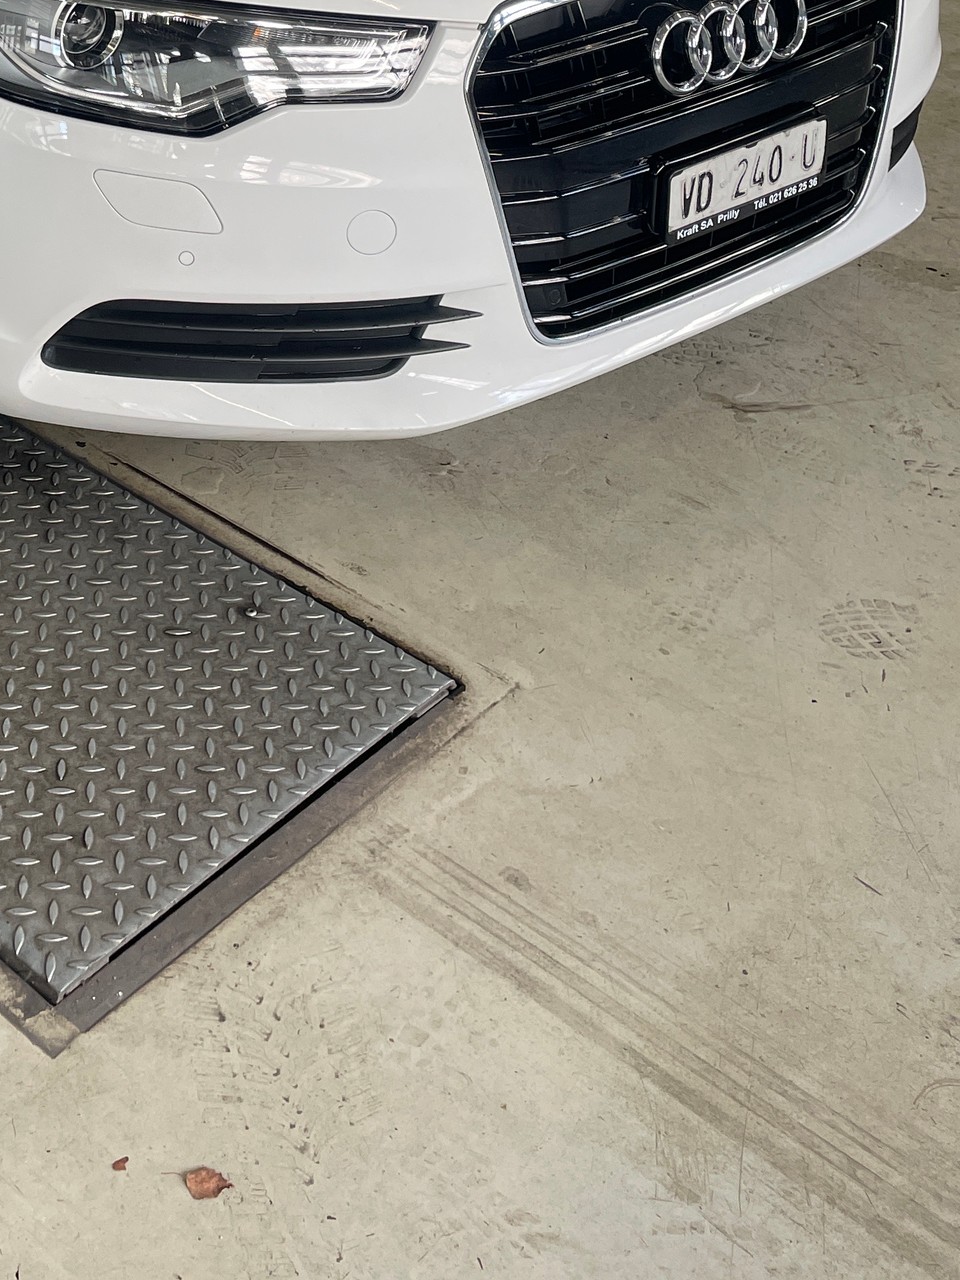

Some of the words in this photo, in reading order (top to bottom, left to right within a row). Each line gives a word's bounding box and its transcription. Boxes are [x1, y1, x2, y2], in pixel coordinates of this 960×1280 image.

[681, 170, 714, 219] VD
[732, 144, 783, 200] 240
[801, 128, 819, 170] U
[676, 224, 699, 240] Kraft
[700, 219, 714, 230] SA
[717, 208, 740, 224] Prilly
[769, 191, 782, 204] 021
[783, 186, 797, 199] 626
[798, 182, 808, 193] 25
